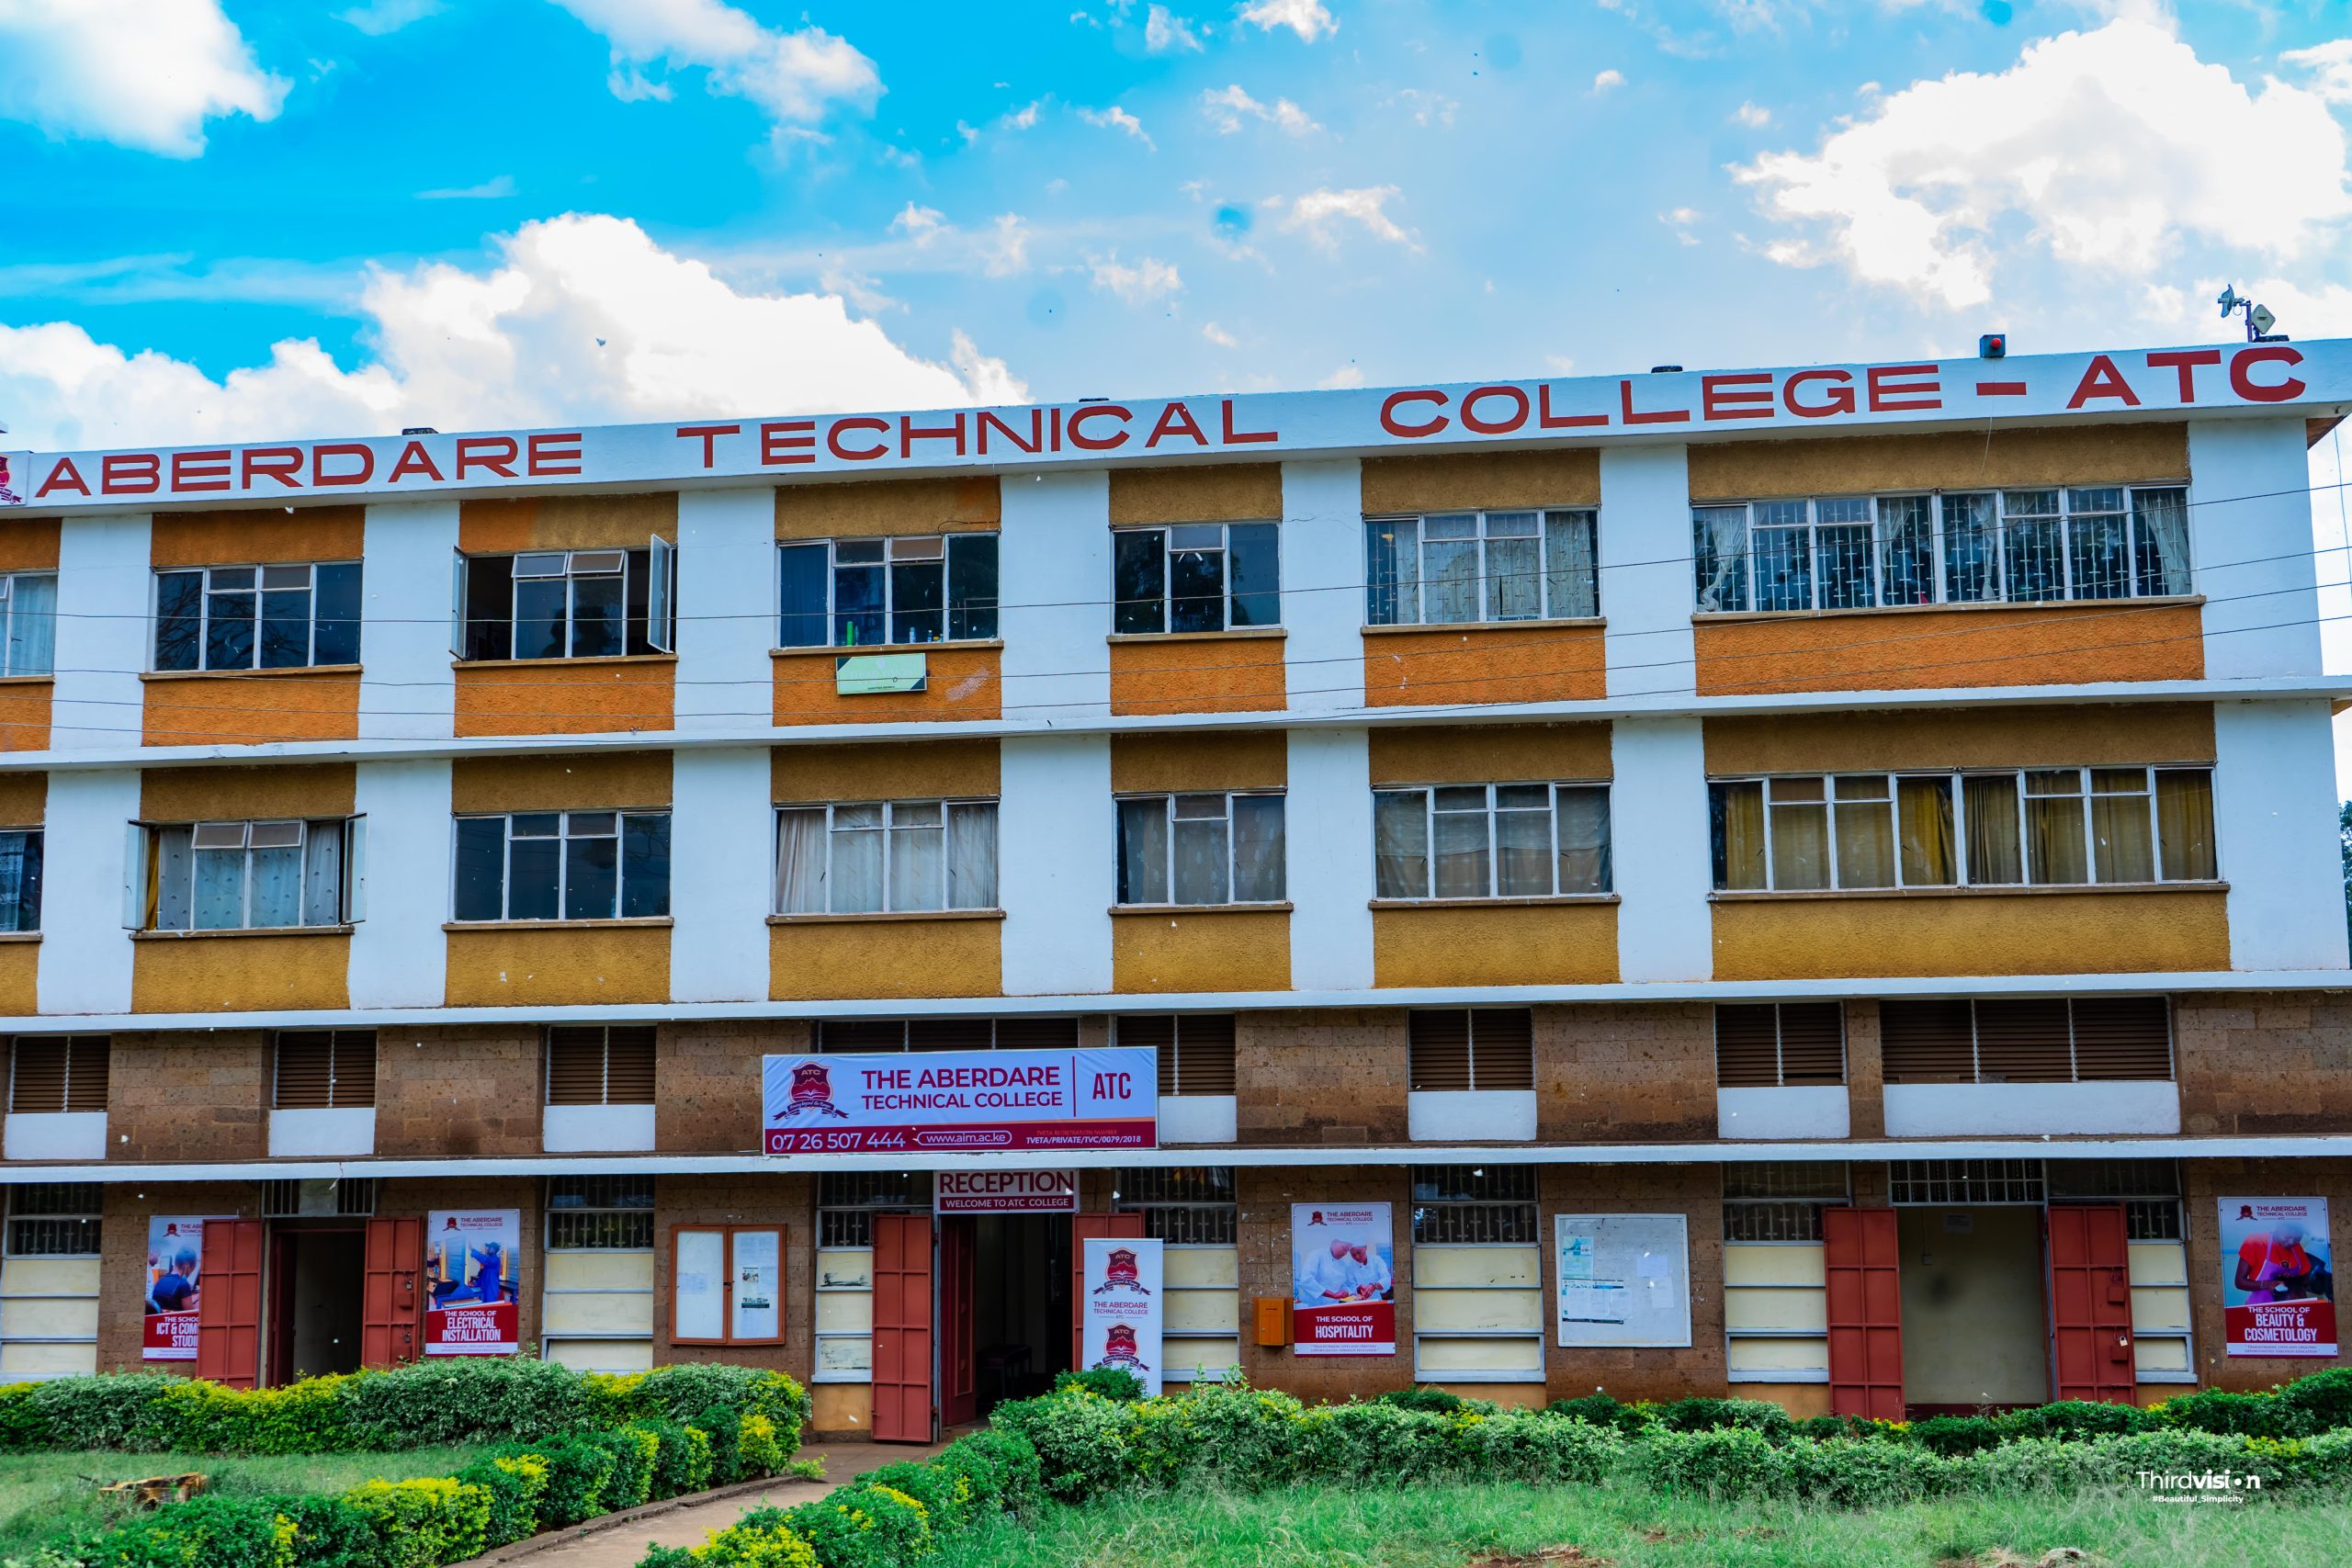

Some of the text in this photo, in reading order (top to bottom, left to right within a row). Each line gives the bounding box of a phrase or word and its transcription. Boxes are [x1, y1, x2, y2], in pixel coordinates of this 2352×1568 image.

[35, 433, 582, 498] ABERDARE
[676, 400, 1278, 468] TECHNICAL
[1380, 365, 1942, 437] COLLEGE
[2066, 346, 2306, 409] ATC
[861, 1066, 1061, 1089] THE ABERDARE
[1092, 1072, 1132, 1100] ATC
[861, 1091, 1063, 1110] TECHNICAL COLLEGE
[771, 1132, 906, 1150] 07 26 507 444
[926, 1133, 1006, 1143] www.aim.ac.ke
[1025, 1135, 1141, 1144] TVETA/PRIVATE/TVC/0079/2018
[940, 1171, 1074, 1193] RECEPTION
[945, 1198, 1069, 1208] WELCOME TO ATC COLLEGE
[447, 1317, 497, 1329] ELECTRICAL
[2256, 1314, 2305, 1327] BEAUTY &
[156, 1323, 170, 1335] ICT
[171, 1323, 177, 1335] &
[442, 1329, 501, 1341] INSTALLATION
[1316, 1325, 1374, 1338] HOSPITALITY
[2245, 1328, 2317, 1341] COSMETOLOGY
